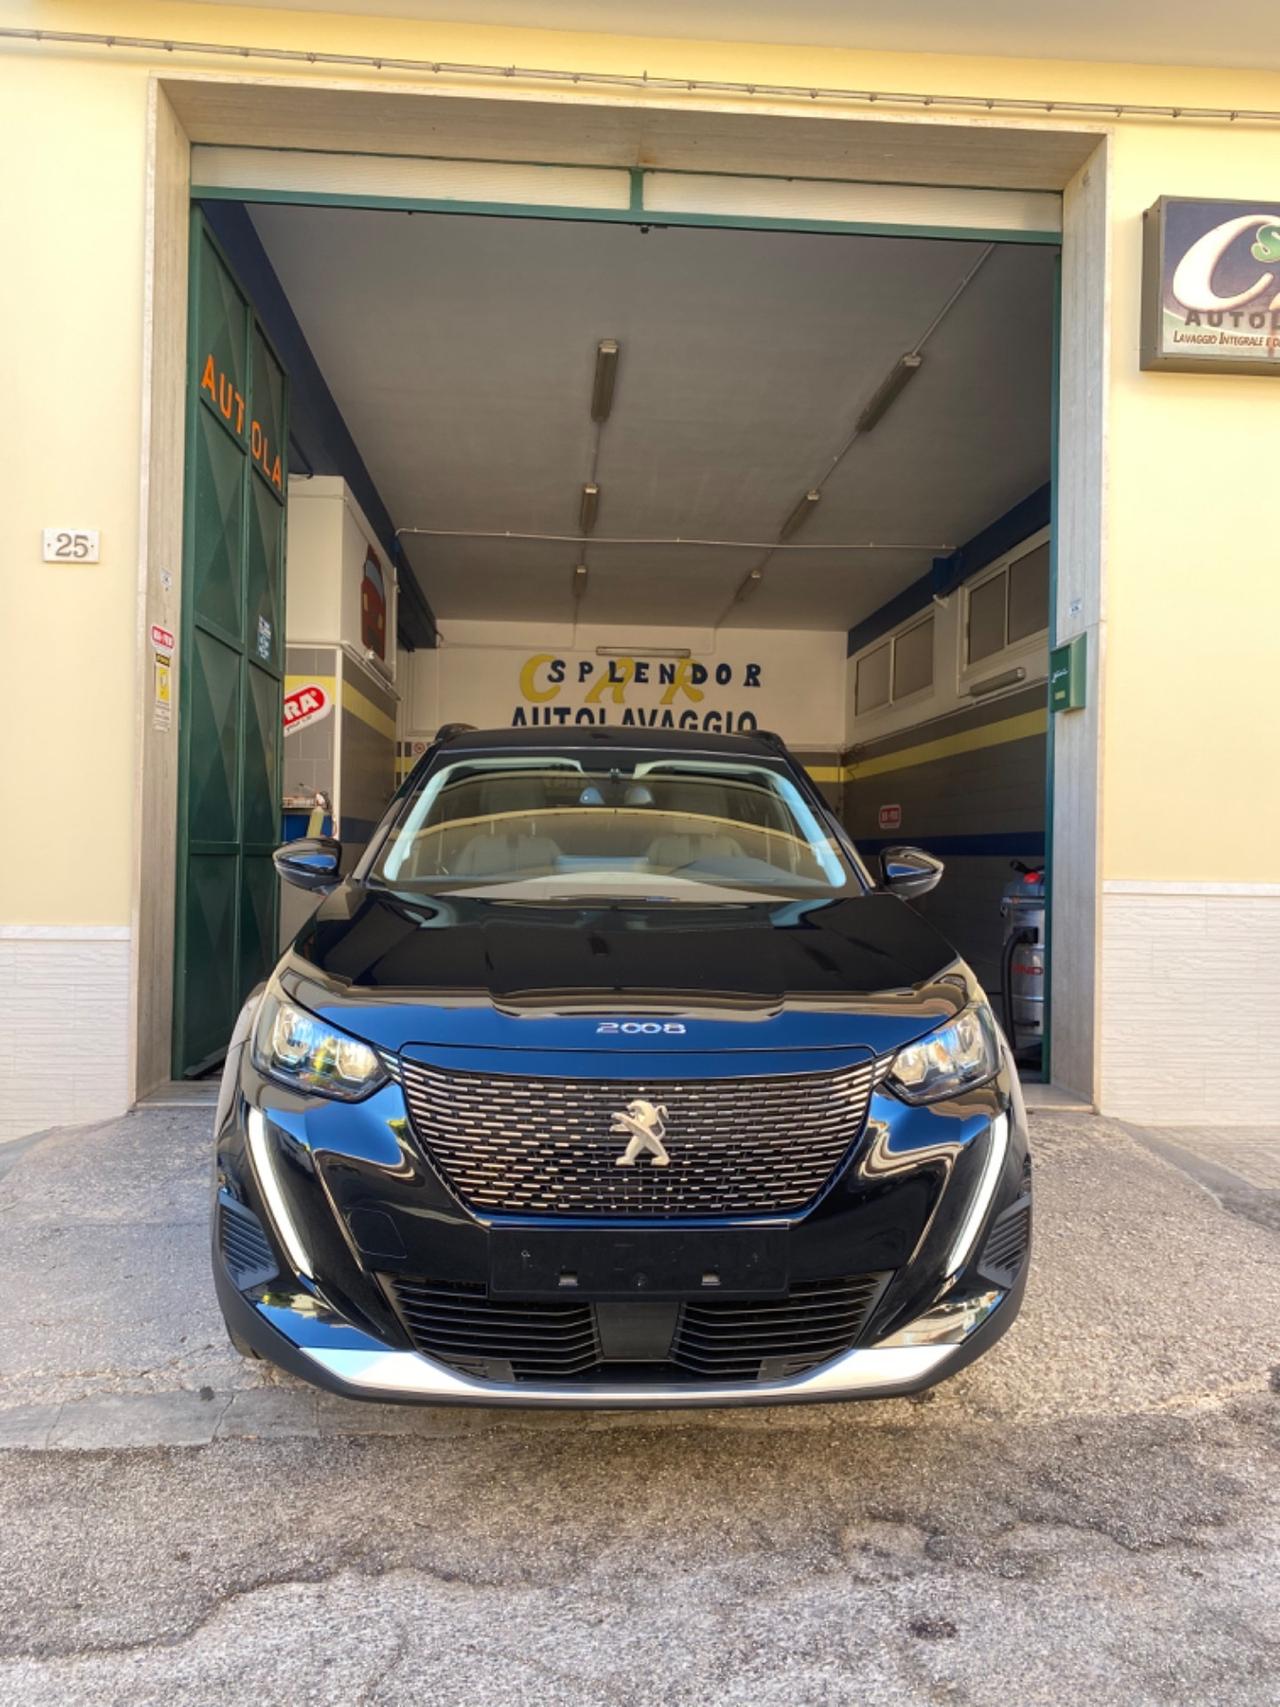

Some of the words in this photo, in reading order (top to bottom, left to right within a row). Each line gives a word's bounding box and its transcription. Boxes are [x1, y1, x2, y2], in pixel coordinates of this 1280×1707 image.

[55, 533, 89, 558] 25
[547, 660, 762, 687] SPLENDOR
[596, 1022, 686, 1034] 2008
